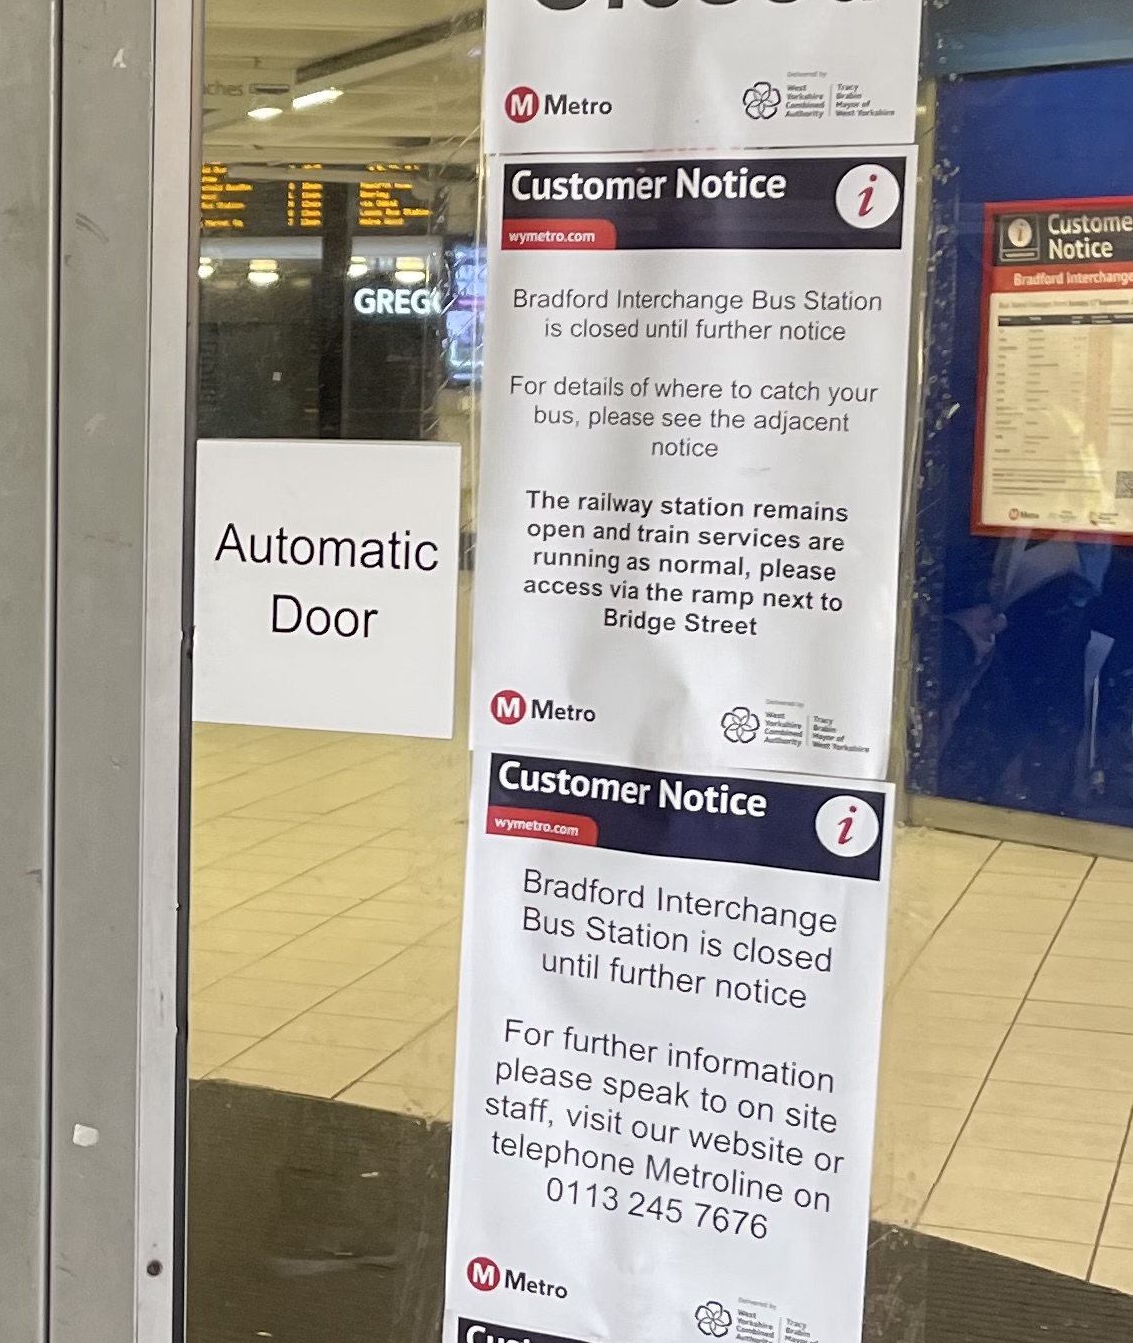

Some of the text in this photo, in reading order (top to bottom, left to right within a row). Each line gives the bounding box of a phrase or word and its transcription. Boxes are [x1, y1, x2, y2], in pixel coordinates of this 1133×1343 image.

[544, 93, 613, 116] Metro
[510, 166, 789, 203] Customer Notice
[508, 230, 596, 246] wymetro.com
[1048, 213, 1133, 235] Custome
[1049, 237, 1113, 259] Notice
[1013, 272, 1064, 286] Bradford
[354, 288, 441, 314] GREG
[513, 288, 882, 315] Bradford Interchange Bus Station
[544, 317, 846, 342] is closed until further notice
[510, 374, 879, 407] For details of where to catch your
[534, 404, 850, 436] bus, please see the adjacent
[651, 437, 719, 458] notice
[525, 489, 849, 523] The railway station remains
[214, 522, 439, 572] Automatic
[527, 522, 845, 552] open and train services are
[533, 548, 836, 582] running as normal, please
[523, 579, 843, 612] access via the ramp next to
[271, 594, 379, 638] Door
[603, 607, 758, 636] Bridge Street
[531, 698, 596, 722] Metro
